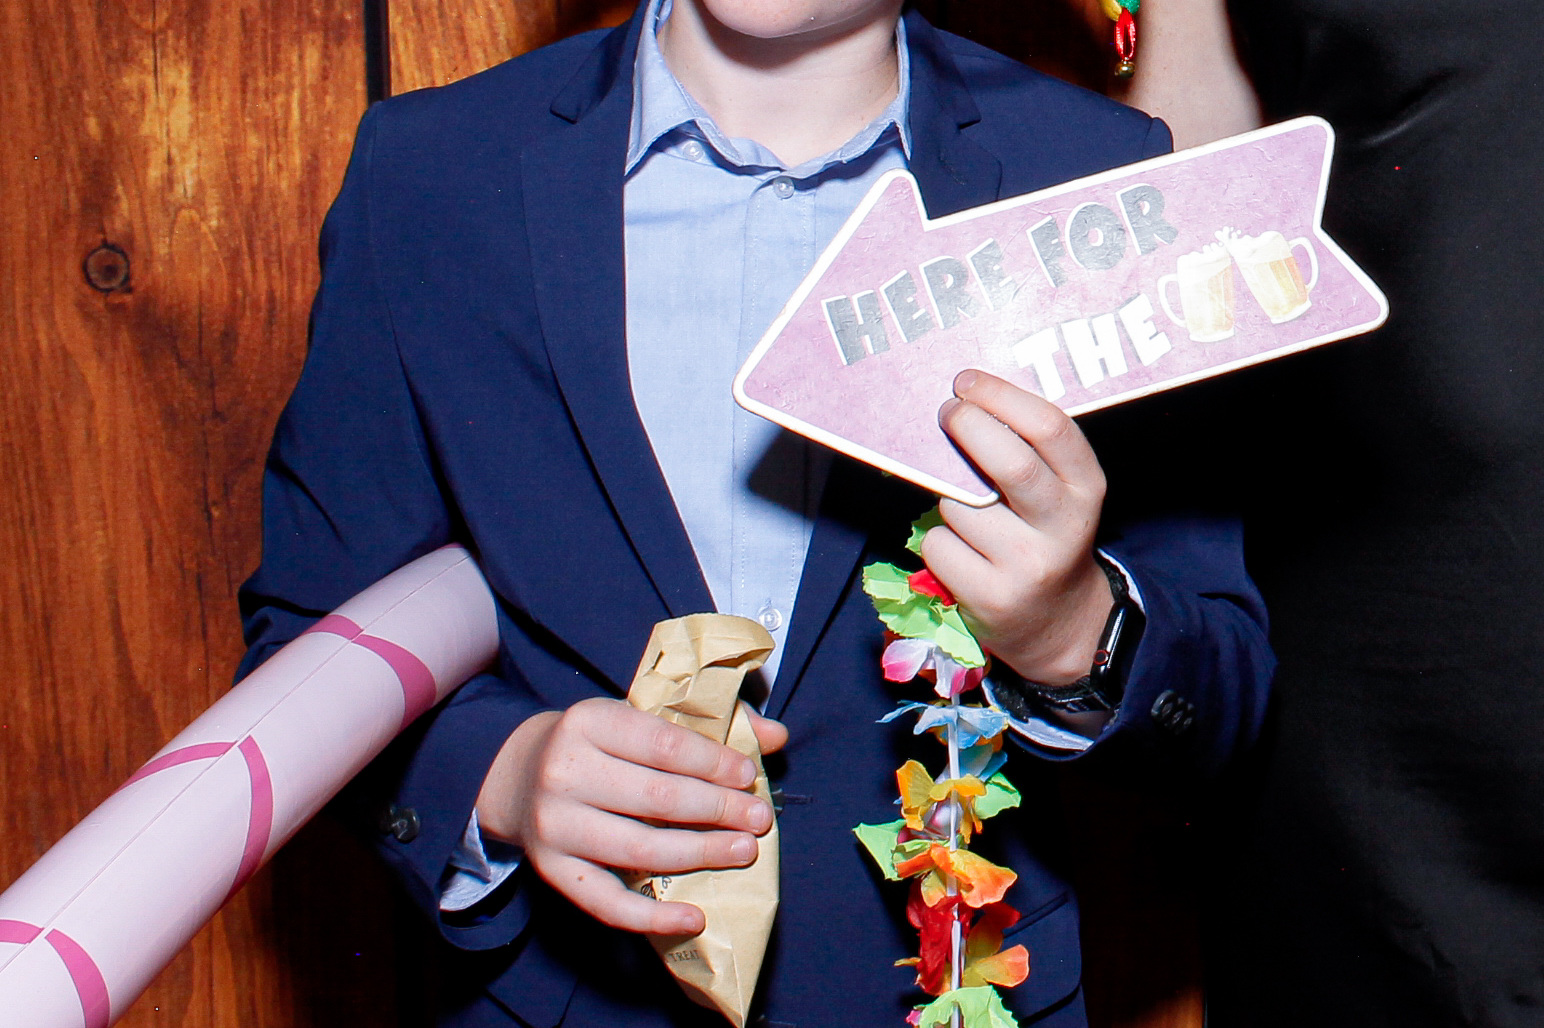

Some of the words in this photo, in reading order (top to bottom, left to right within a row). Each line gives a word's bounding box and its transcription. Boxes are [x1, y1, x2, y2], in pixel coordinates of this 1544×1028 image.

[821, 237, 1018, 366] HERE
[1026, 183, 1179, 288] FOR
[1012, 292, 1172, 403] THE
